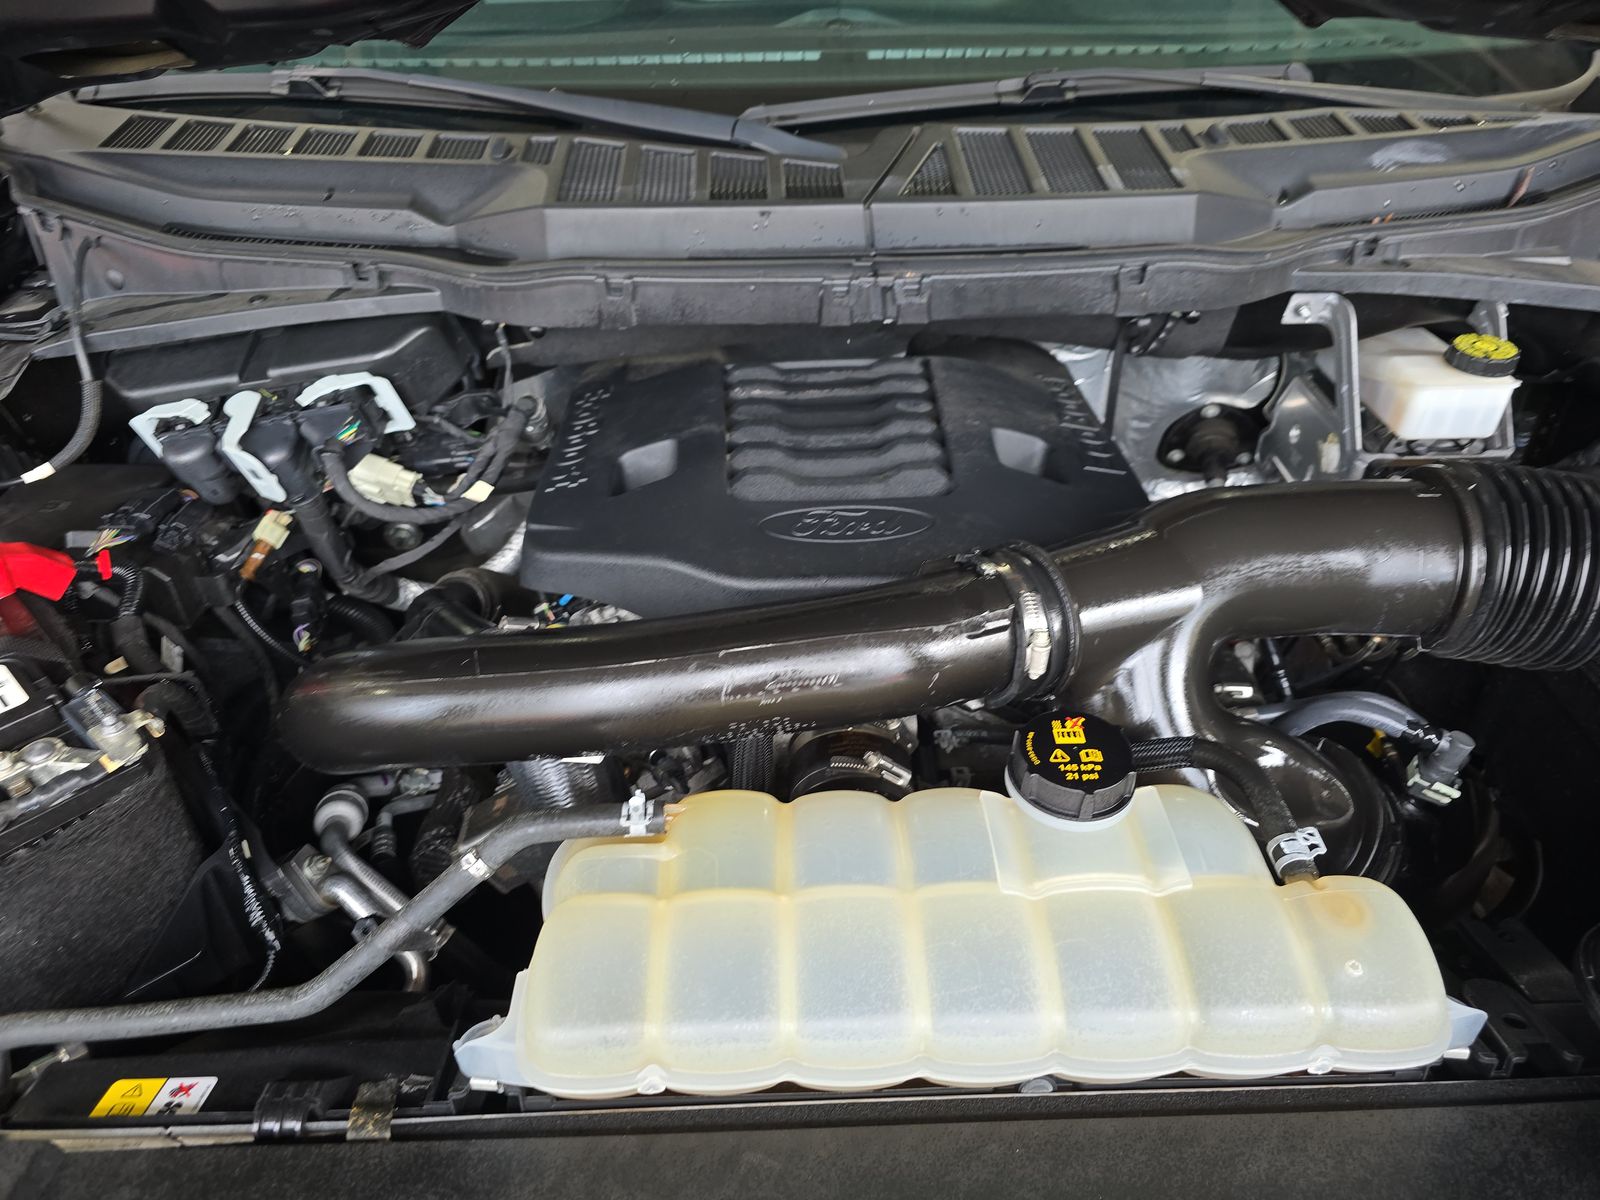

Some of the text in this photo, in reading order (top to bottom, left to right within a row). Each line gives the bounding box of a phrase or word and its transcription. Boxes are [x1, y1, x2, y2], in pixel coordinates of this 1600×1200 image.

[790, 509, 903, 537] Ford
[1065, 772, 1099, 781] 21 psi
